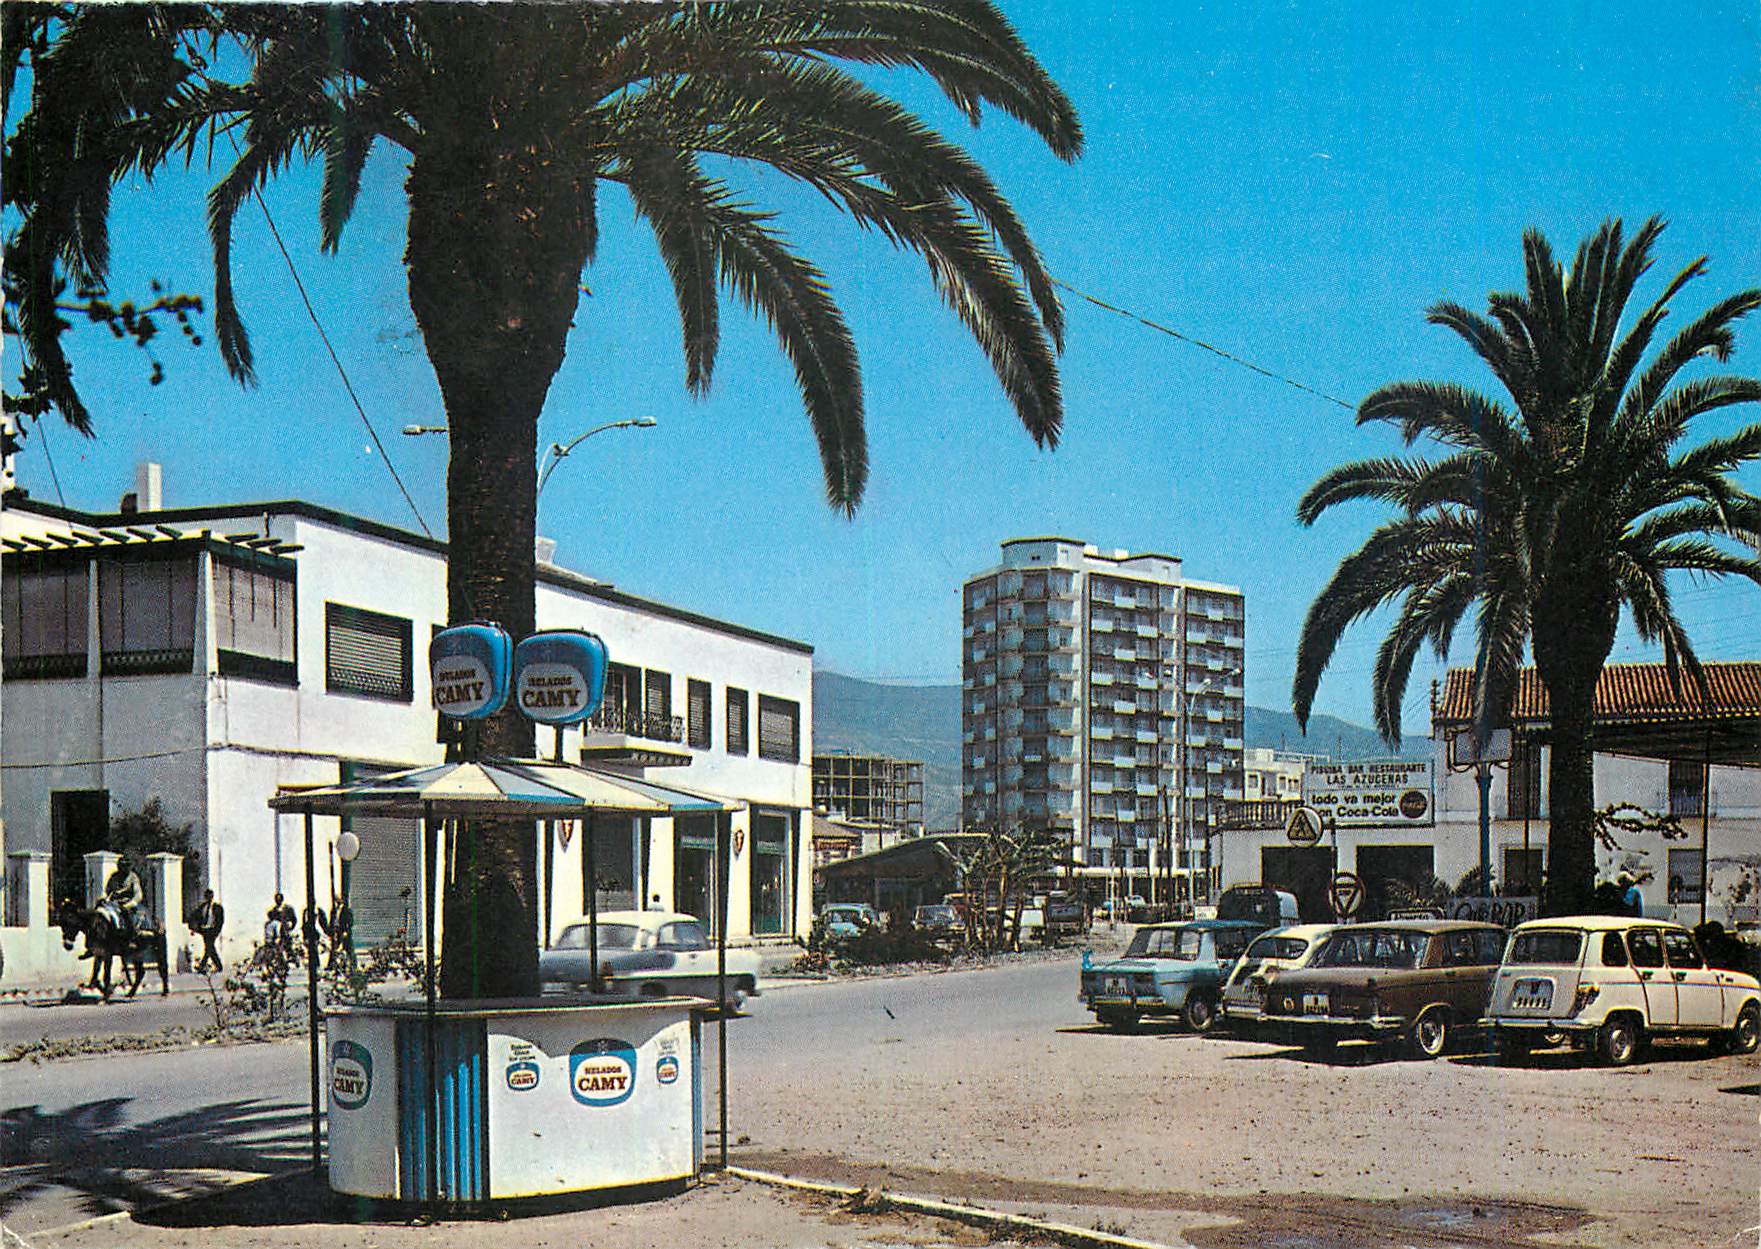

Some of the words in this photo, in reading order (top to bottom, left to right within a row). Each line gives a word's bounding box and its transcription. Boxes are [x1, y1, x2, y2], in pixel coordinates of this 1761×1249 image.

[435, 681, 484, 704] CAMY
[522, 688, 581, 707] CAMY
[1369, 763, 1425, 773] RESTAURANTE
[1327, 774, 1346, 784] LAS
[1354, 773, 1409, 785] AZUCENAS
[1311, 793, 1338, 804] todo
[1344, 795, 1358, 804] va
[1363, 792, 1395, 806] mejor
[511, 1077, 535, 1085] CAMY
[578, 1076, 628, 1091] CAMY
